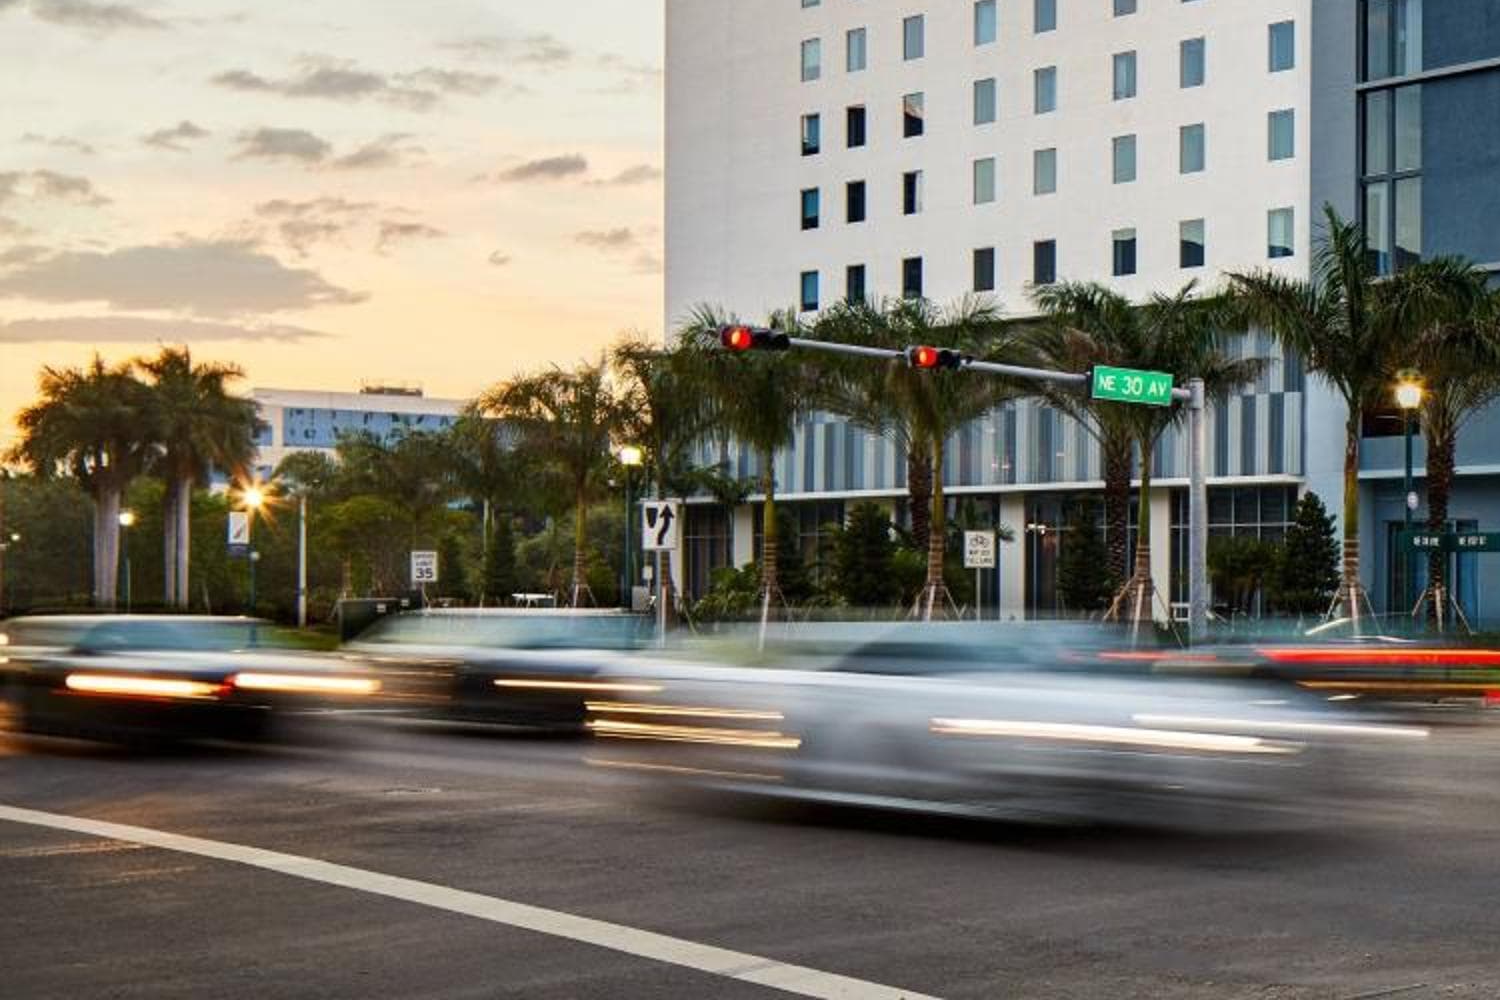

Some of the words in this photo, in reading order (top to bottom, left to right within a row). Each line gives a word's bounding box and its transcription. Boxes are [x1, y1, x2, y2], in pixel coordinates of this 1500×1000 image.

[1098, 373, 1116, 391] NE
[1122, 375, 1143, 395] 30
[1147, 380, 1167, 397] AV
[416, 567, 433, 579] 35
